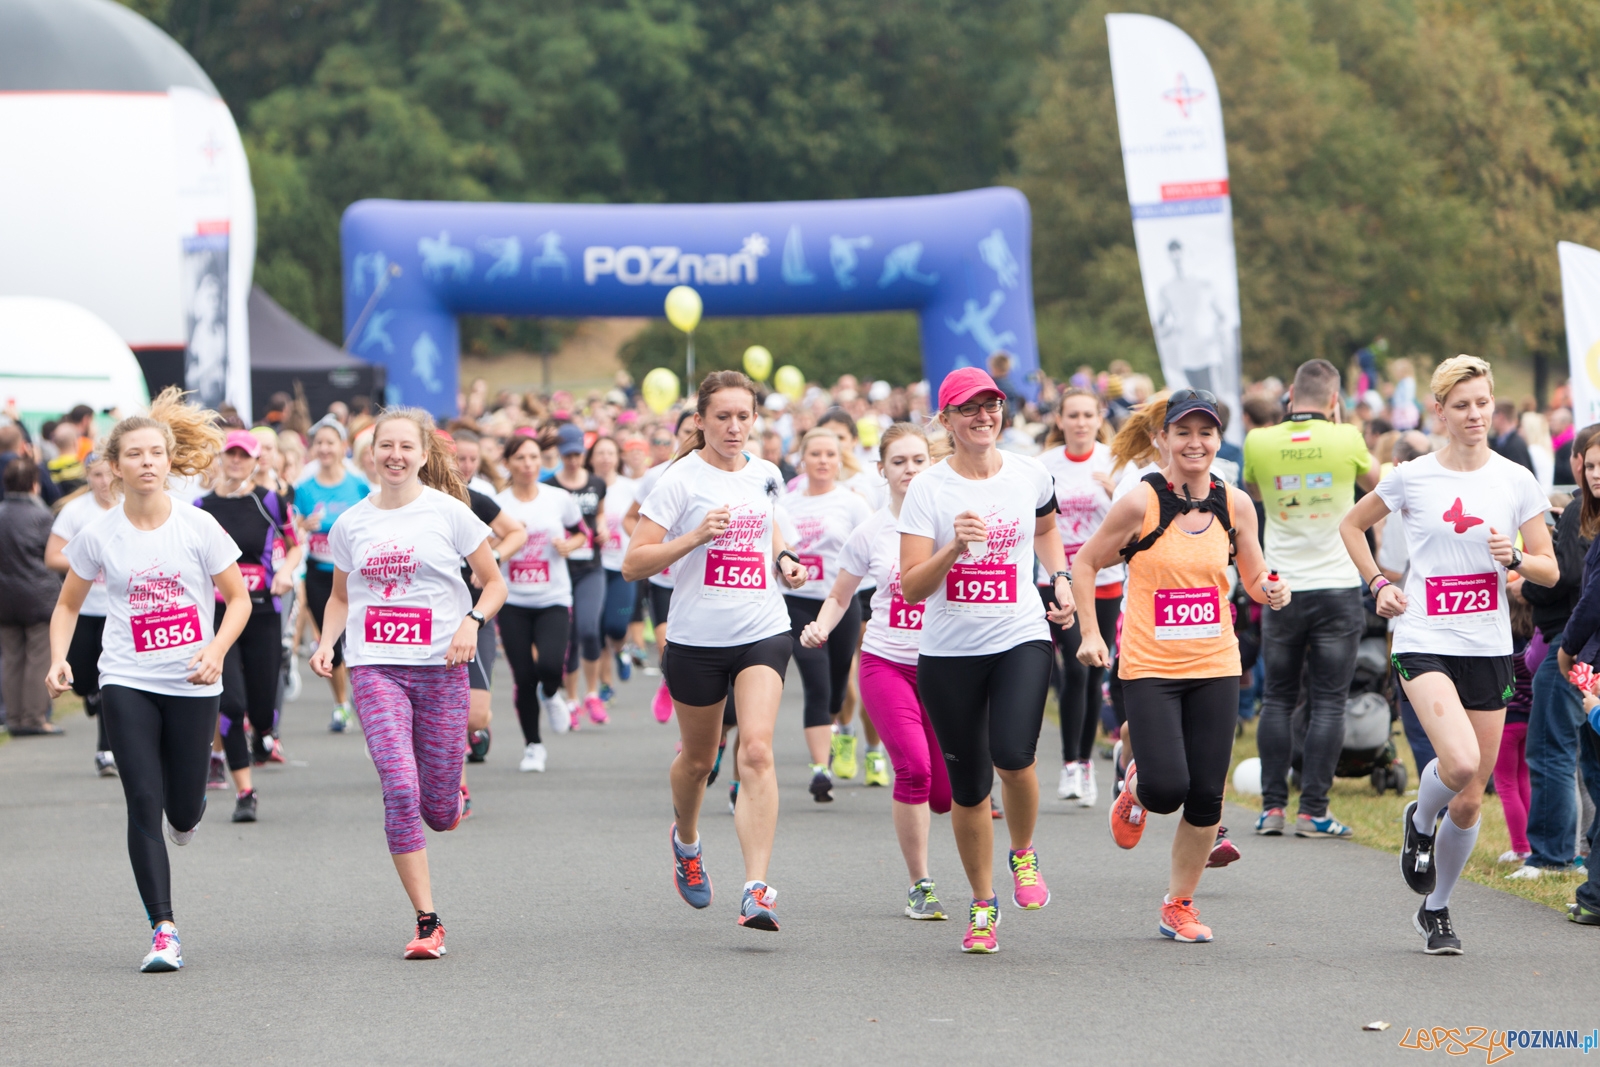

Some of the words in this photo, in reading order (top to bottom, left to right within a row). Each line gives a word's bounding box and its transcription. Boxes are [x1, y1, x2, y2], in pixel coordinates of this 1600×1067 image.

[727, 519, 763, 529] awsze
[986, 528, 1016, 541] wsze
[987, 536, 1021, 552] (w)si!
[366, 555, 411, 566] zawsze
[512, 568, 546, 582] 1676
[714, 565, 762, 587] 1566
[134, 580, 178, 592] zawsze
[954, 580, 1009, 601] 1951
[129, 587, 185, 604] pier(w)si!
[1435, 588, 1491, 613] 1723
[131, 602, 149, 610] 2016
[1163, 602, 1215, 624] 1908
[896, 608, 923, 628] 19
[141, 621, 196, 649] 1856
[372, 621, 423, 643] 1921
